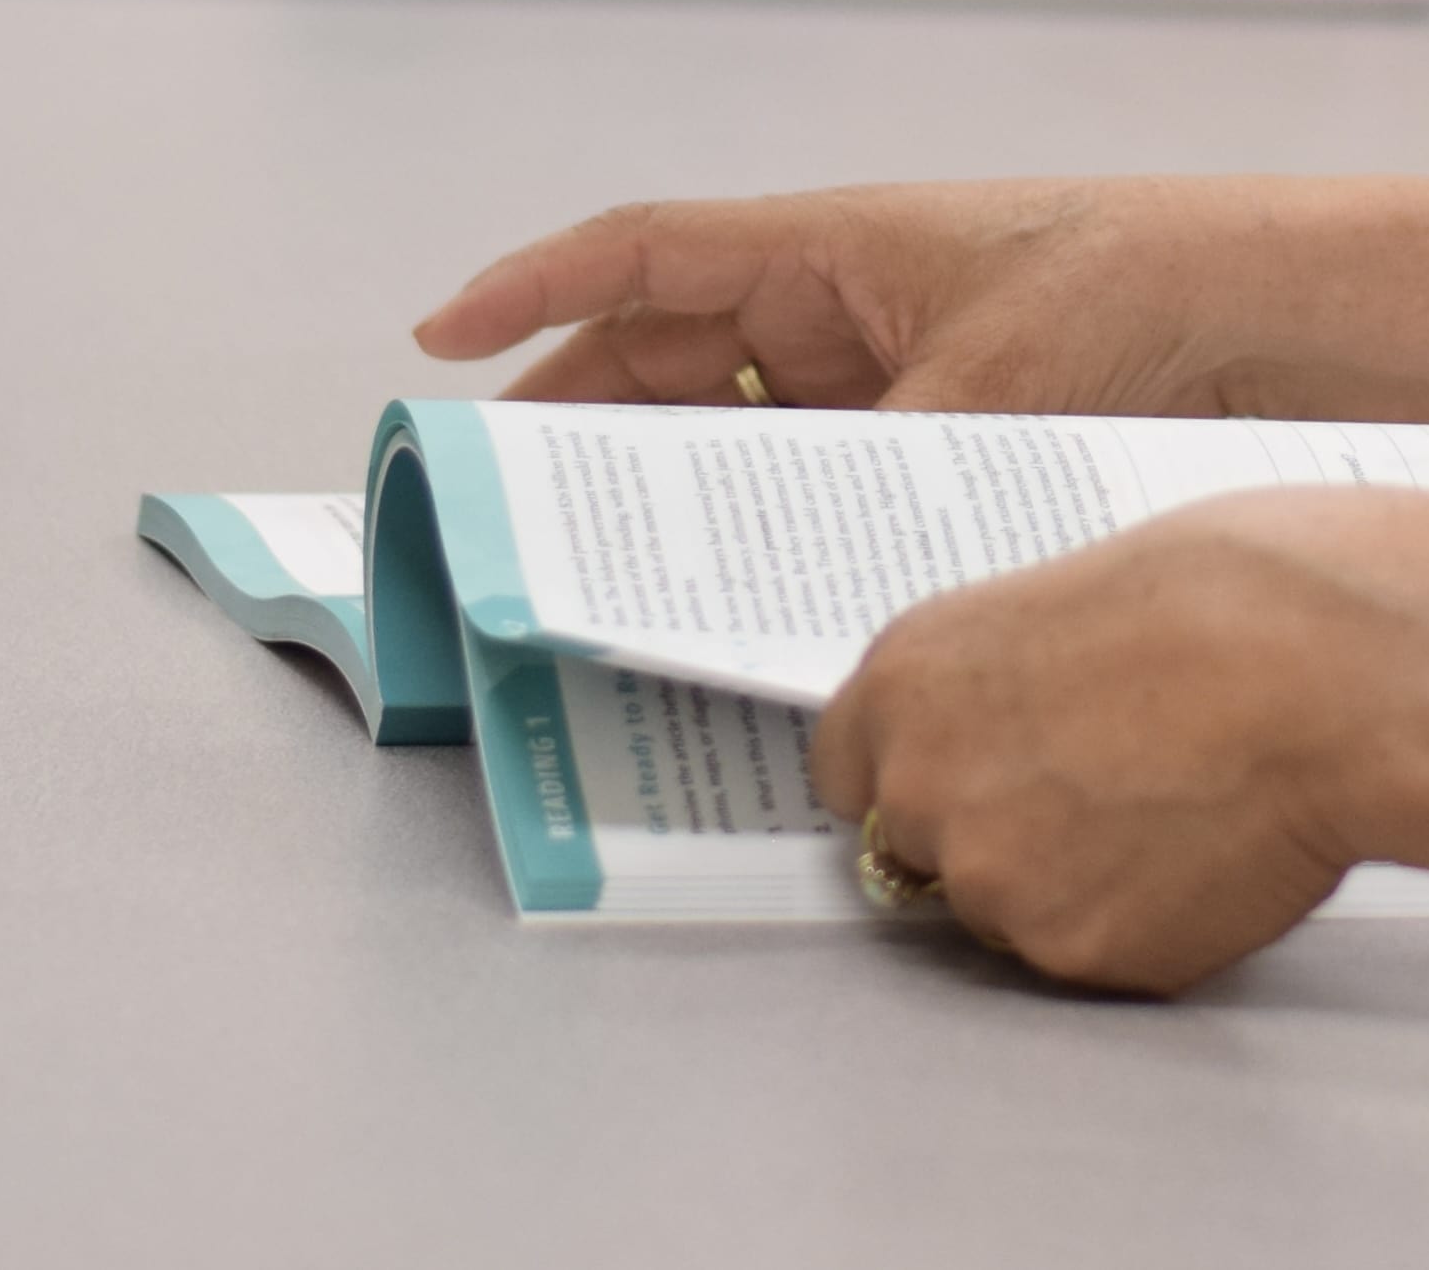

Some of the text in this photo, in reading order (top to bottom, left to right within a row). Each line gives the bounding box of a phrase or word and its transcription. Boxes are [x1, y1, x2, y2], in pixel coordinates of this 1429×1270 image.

[766, 463, 782, 475] the
[742, 471, 765, 506] national
[800, 483, 817, 505] carry
[845, 475, 864, 490] and
[874, 468, 896, 509] Highways
[696, 493, 718, 525] several
[770, 477, 797, 532] transformed
[828, 493, 844, 508] out
[855, 493, 871, 518] home
[901, 473, 925, 528] construction
[993, 489, 1012, 523] existing
[585, 491, 612, 547] government
[756, 510, 780, 551] promote
[803, 508, 823, 533] could
[834, 511, 850, 534] move
[1024, 511, 1040, 531] were
[645, 537, 662, 551] the
[705, 528, 723, 546] had
[787, 537, 803, 555] they
[863, 521, 882, 560] between
[913, 531, 935, 560] initial
[623, 556, 639, 569] the
[763, 554, 781, 571] and
[813, 537, 831, 568] Trucks
[837, 537, 857, 564] could
[982, 542, 996, 565] were
[571, 557, 588, 574] and
[871, 564, 890, 589] easily
[847, 567, 866, 599] People
[623, 702, 645, 725] to
[667, 721, 690, 761] article
[699, 733, 716, 747] or
[746, 738, 765, 763] this
[626, 733, 660, 796] Ready
[677, 764, 694, 786] the
[524, 716, 576, 841] READING 1
[644, 805, 671, 835] Get
